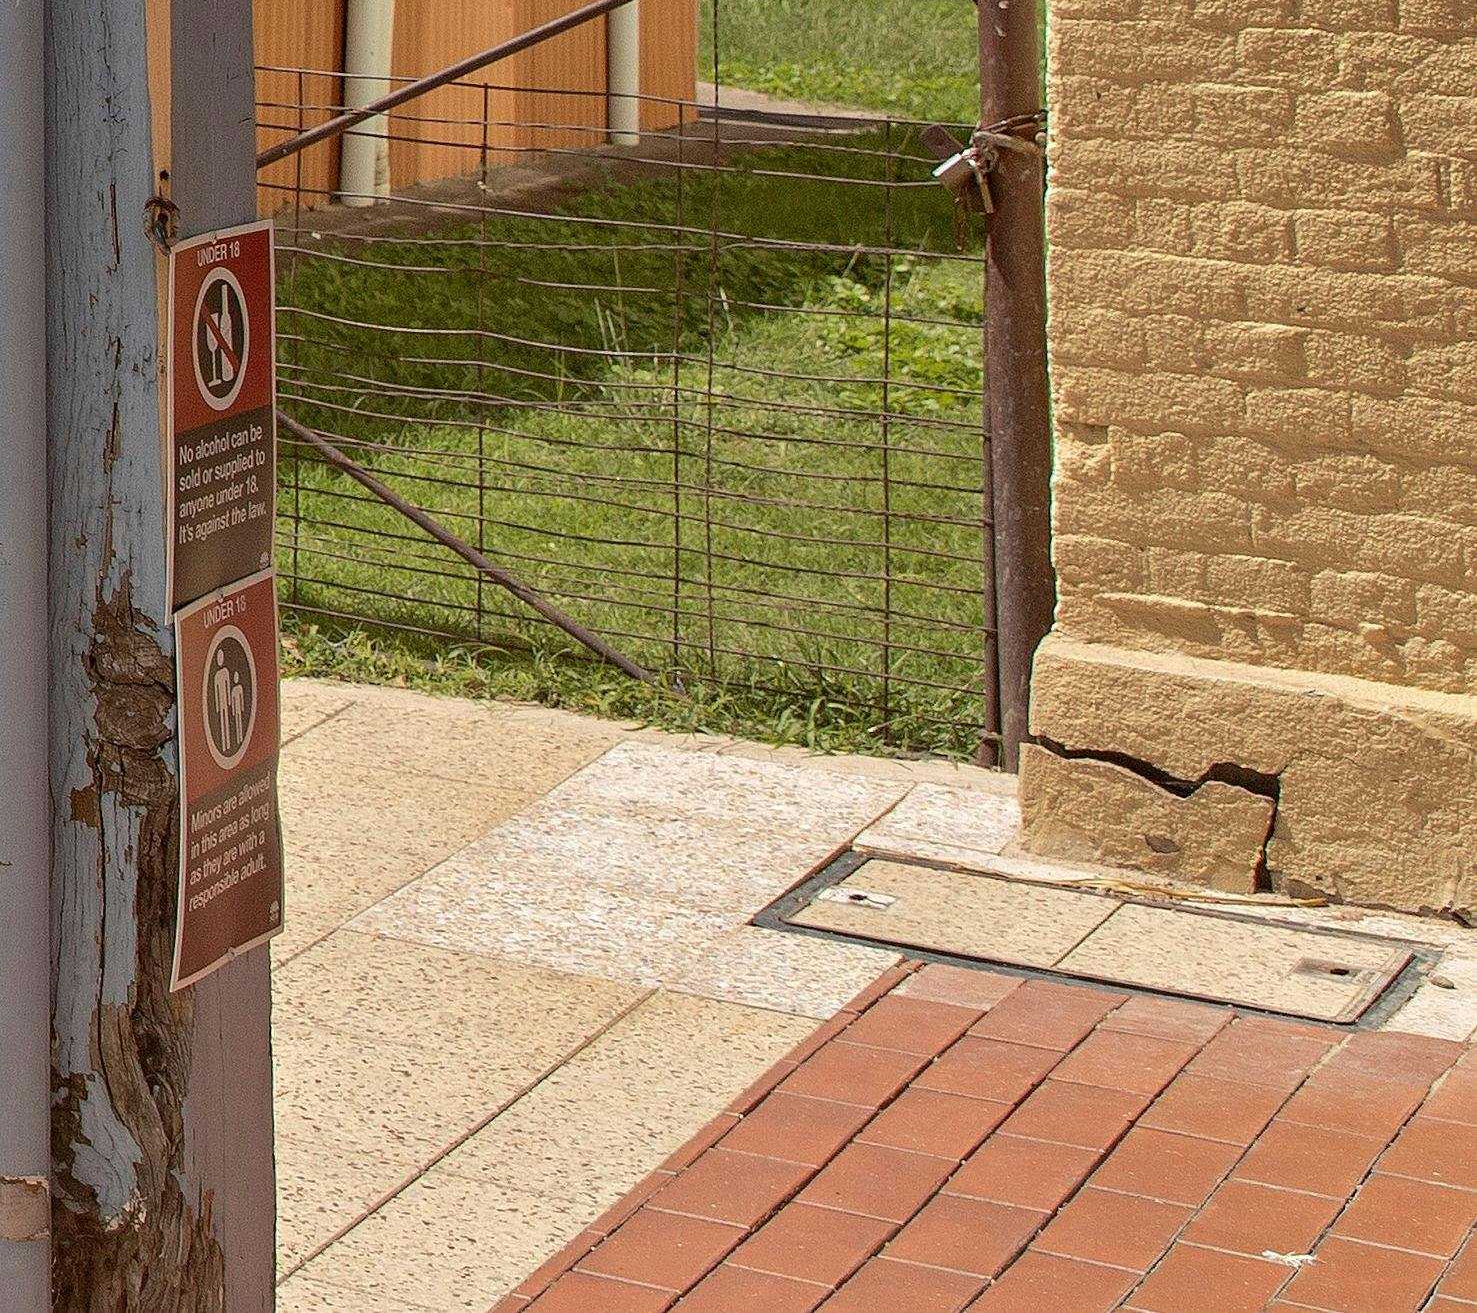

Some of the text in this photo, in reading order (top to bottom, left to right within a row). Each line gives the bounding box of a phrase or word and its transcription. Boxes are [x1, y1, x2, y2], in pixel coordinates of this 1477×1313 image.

[197, 240, 240, 267] UNDER 18
[179, 424, 262, 466] No alcohol can be
[179, 448, 266, 492] sold or supplied to
[179, 474, 259, 519] anyone under 18.
[179, 501, 267, 544] It's against the law.
[203, 595, 247, 629] UNDER 18
[191, 772, 270, 833] Minors are allowed
[191, 801, 269, 860] in this area as long
[190, 830, 265, 885] as they are with a
[189, 853, 267, 912] responsible adult.
